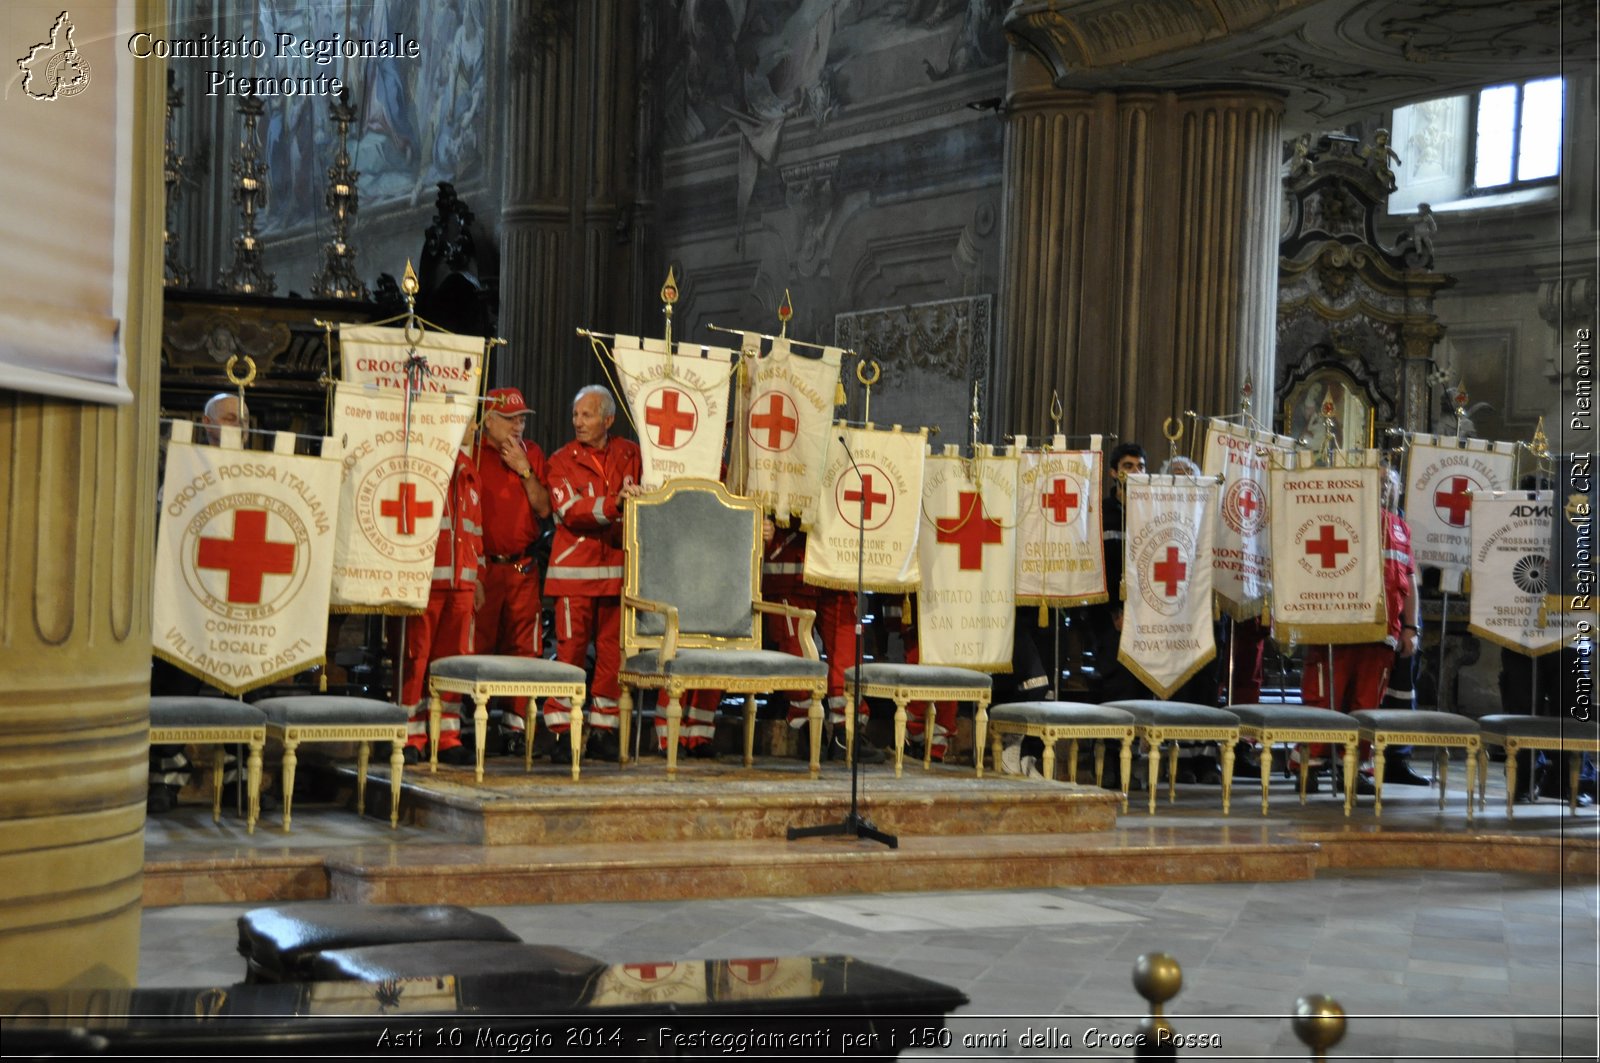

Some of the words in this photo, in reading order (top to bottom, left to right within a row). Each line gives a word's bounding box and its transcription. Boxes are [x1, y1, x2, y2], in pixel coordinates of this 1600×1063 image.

[345, 406, 372, 420] CORPO
[851, 448, 877, 461] OSSA
[1416, 463, 1440, 491] CROCE
[1440, 455, 1469, 469] ROSSA
[1283, 480, 1324, 490] CROCE
[1327, 480, 1365, 489] ROSSA
[168, 470, 216, 518] CROCE
[218, 463, 277, 481] ROSSA
[280, 470, 331, 537] ITALIANA
[1296, 494, 1354, 504] ITALIANA
[1295, 519, 1314, 545] CORPO
[1317, 514, 1359, 544] VOLONTARI
[1426, 533, 1462, 545] GRUPPO
[836, 550, 893, 565] MONALVO
[1298, 557, 1314, 574] DEL
[1315, 557, 1358, 579] SOCCORSO
[1299, 591, 1344, 600] GRUPPO
[1347, 591, 1359, 599] DI
[205, 619, 277, 638] COMITATO
[1485, 618, 1530, 627] CASTELLO
[165, 626, 254, 678] VILLANOVA
[260, 637, 312, 675] D'ASTI
[209, 639, 268, 656] LOCALE
